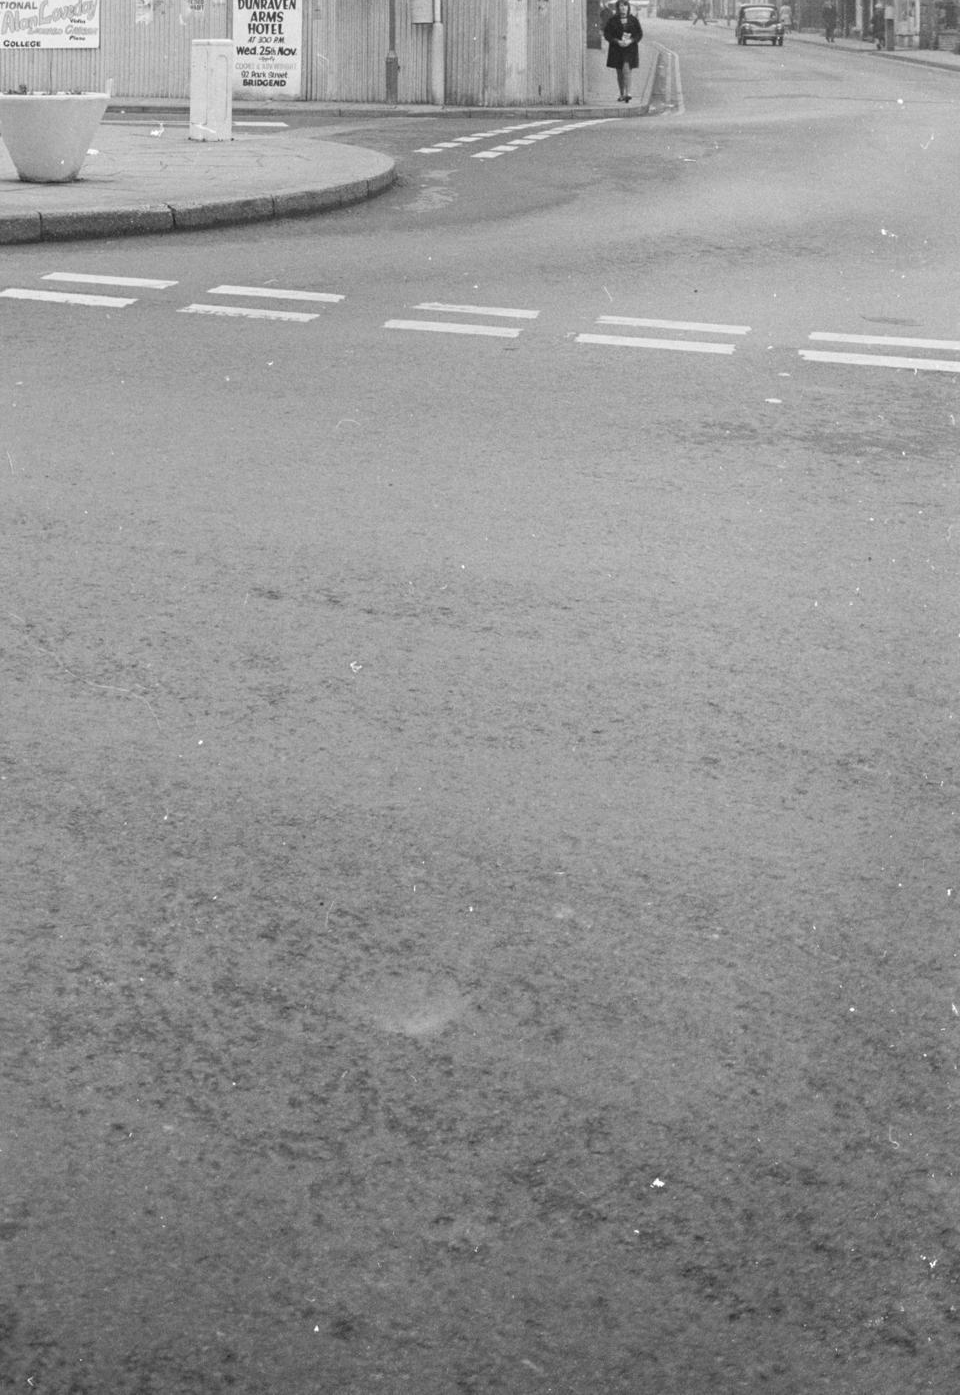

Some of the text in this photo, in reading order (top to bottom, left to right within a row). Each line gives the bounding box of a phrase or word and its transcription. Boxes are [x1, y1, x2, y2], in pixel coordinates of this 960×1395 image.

[250, 10, 284, 22] ARMS
[0, 10, 38, 35] Alan
[247, 23, 284, 35] HOTEL
[247, 36, 256, 44] AT
[251, 70, 267, 78] Park
[268, 70, 288, 79] Street
[242, 78, 287, 87] BRIDGEND
